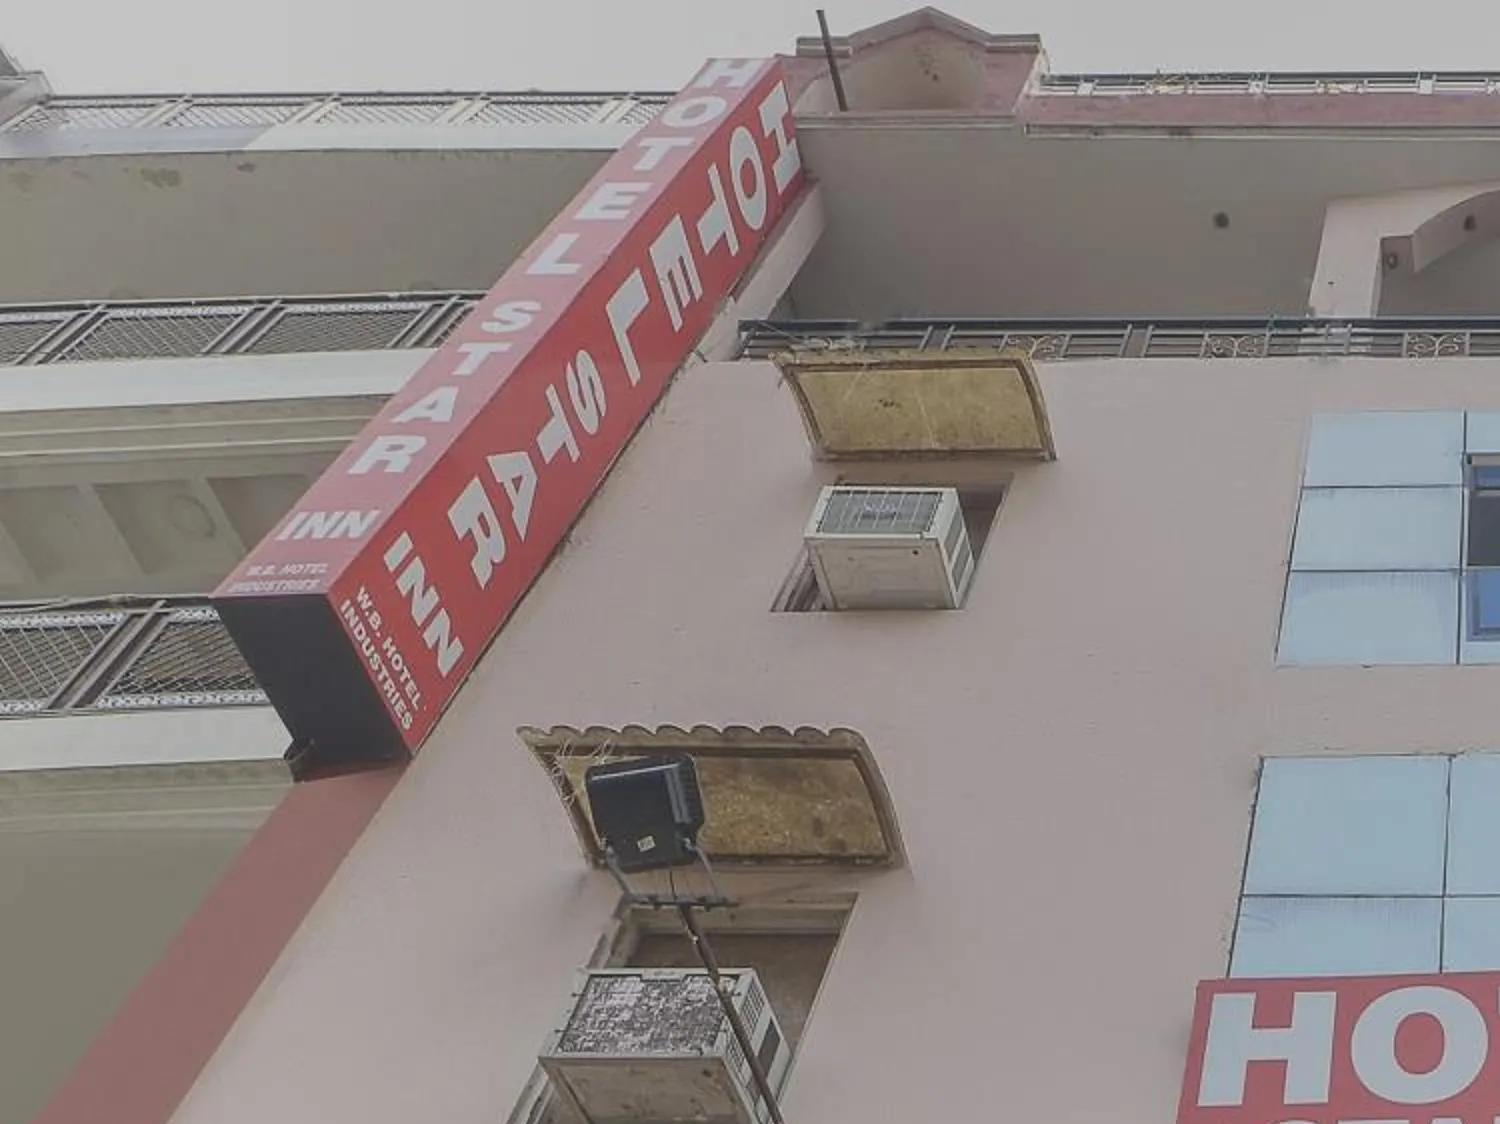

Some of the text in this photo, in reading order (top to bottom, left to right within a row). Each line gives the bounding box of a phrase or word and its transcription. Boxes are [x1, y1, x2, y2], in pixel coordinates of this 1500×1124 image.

[525, 58, 760, 275] HOTEL
[605, 80, 801, 387] HOTEL
[348, 301, 542, 475] STAR
[274, 511, 381, 541] INN
[447, 350, 607, 590] STAR
[340, 599, 413, 730] INDUSTRIES
[382, 635, 420, 711] HOTEL
[383, 531, 464, 678] INN
